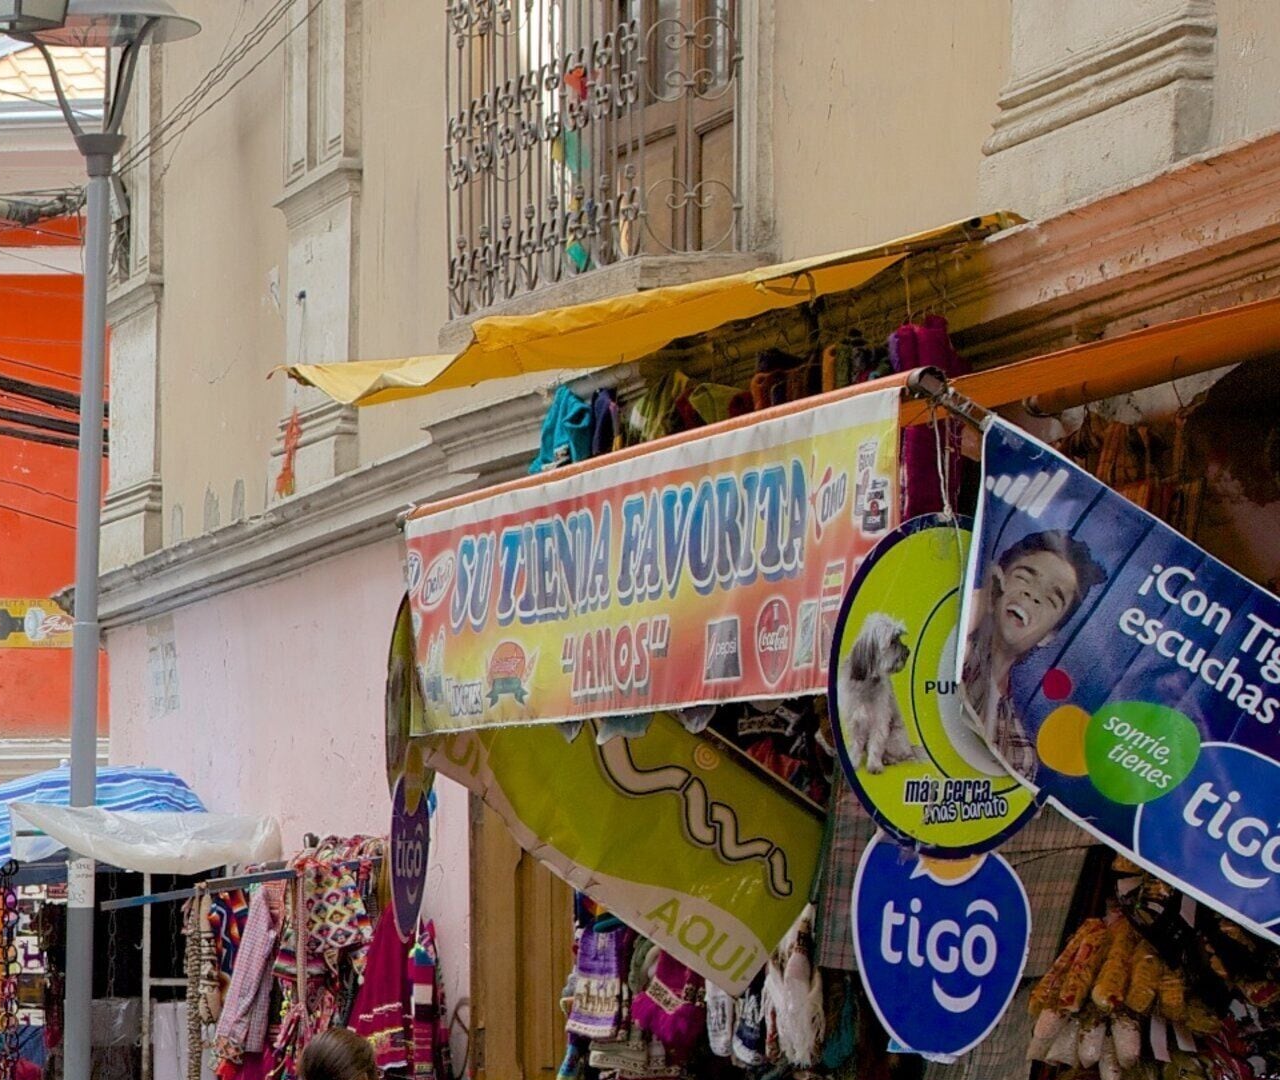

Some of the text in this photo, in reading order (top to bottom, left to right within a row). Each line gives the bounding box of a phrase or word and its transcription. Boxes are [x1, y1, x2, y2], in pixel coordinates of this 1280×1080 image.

[451, 532, 496, 632] SU
[618, 459, 808, 604] FAVORITA
[1138, 563, 1232, 636] ¡Con
[714, 638, 737, 658] pepsi
[1119, 606, 1280, 725] escuchas
[1103, 716, 1171, 765] sonríe,
[1107, 743, 1173, 790] tienes
[944, 780, 991, 803] cerca
[961, 796, 1009, 822] barato
